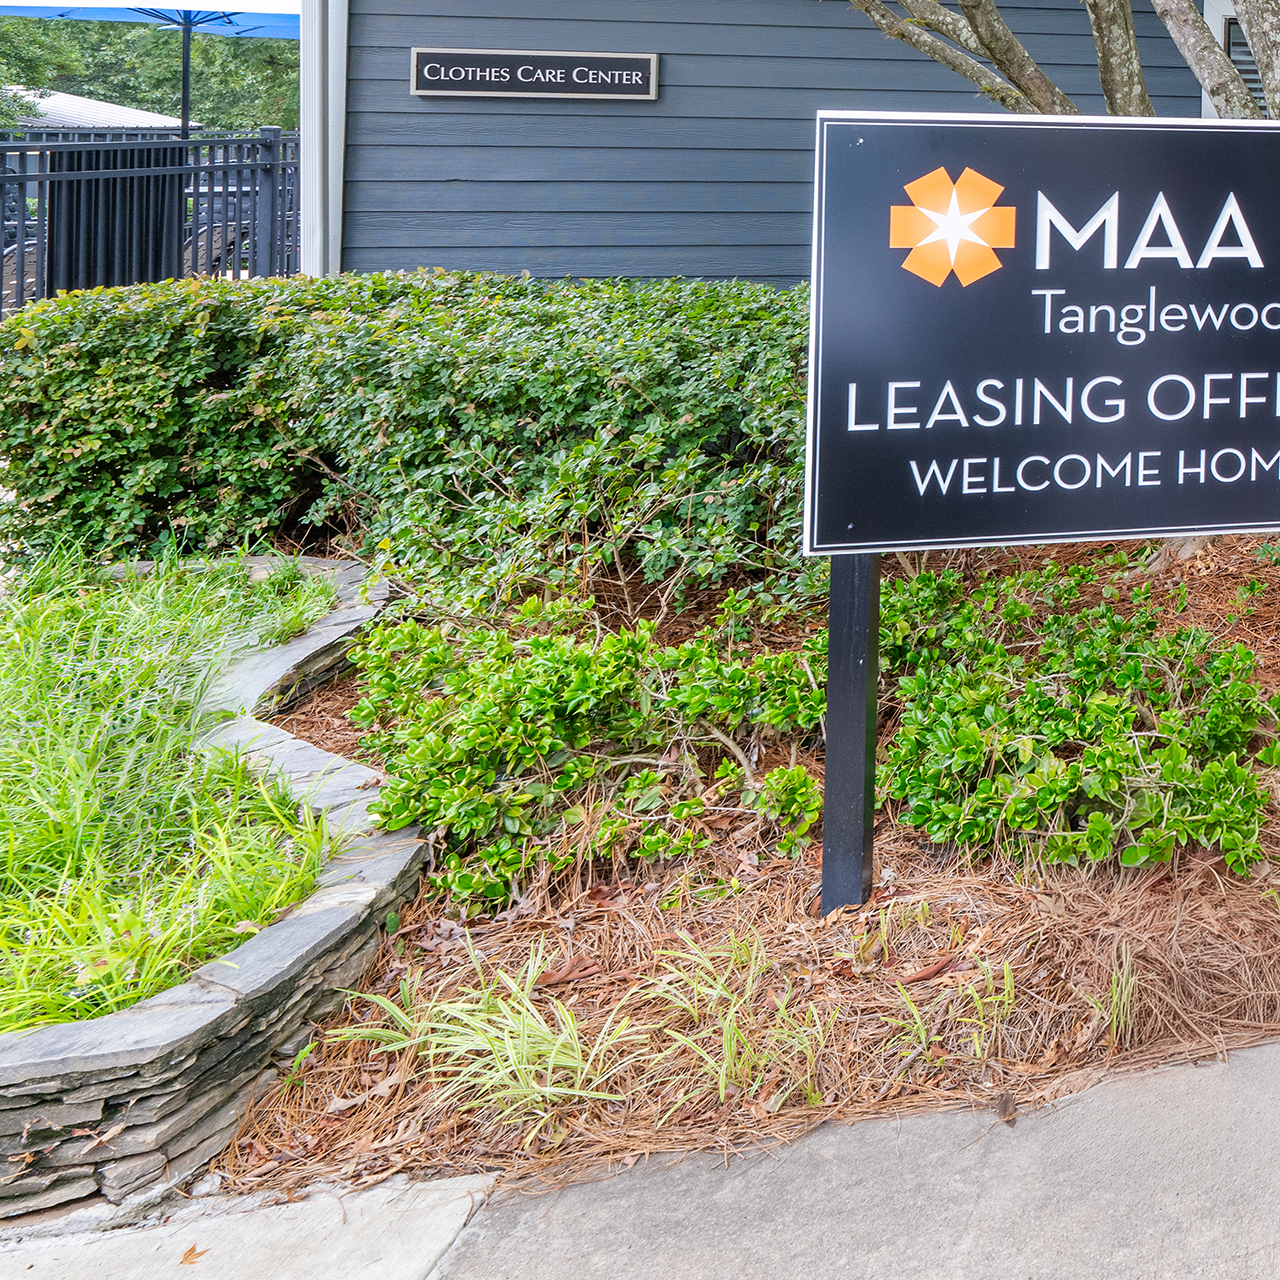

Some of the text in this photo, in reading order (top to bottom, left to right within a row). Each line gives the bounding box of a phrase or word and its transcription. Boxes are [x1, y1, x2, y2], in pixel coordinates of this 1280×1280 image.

[423, 63, 643, 84] CLOTHES CARE CENTER
[1035, 190, 1264, 269] MAA
[848, 376, 1126, 431] LEASING
[909, 451, 1161, 496] WELCOME
